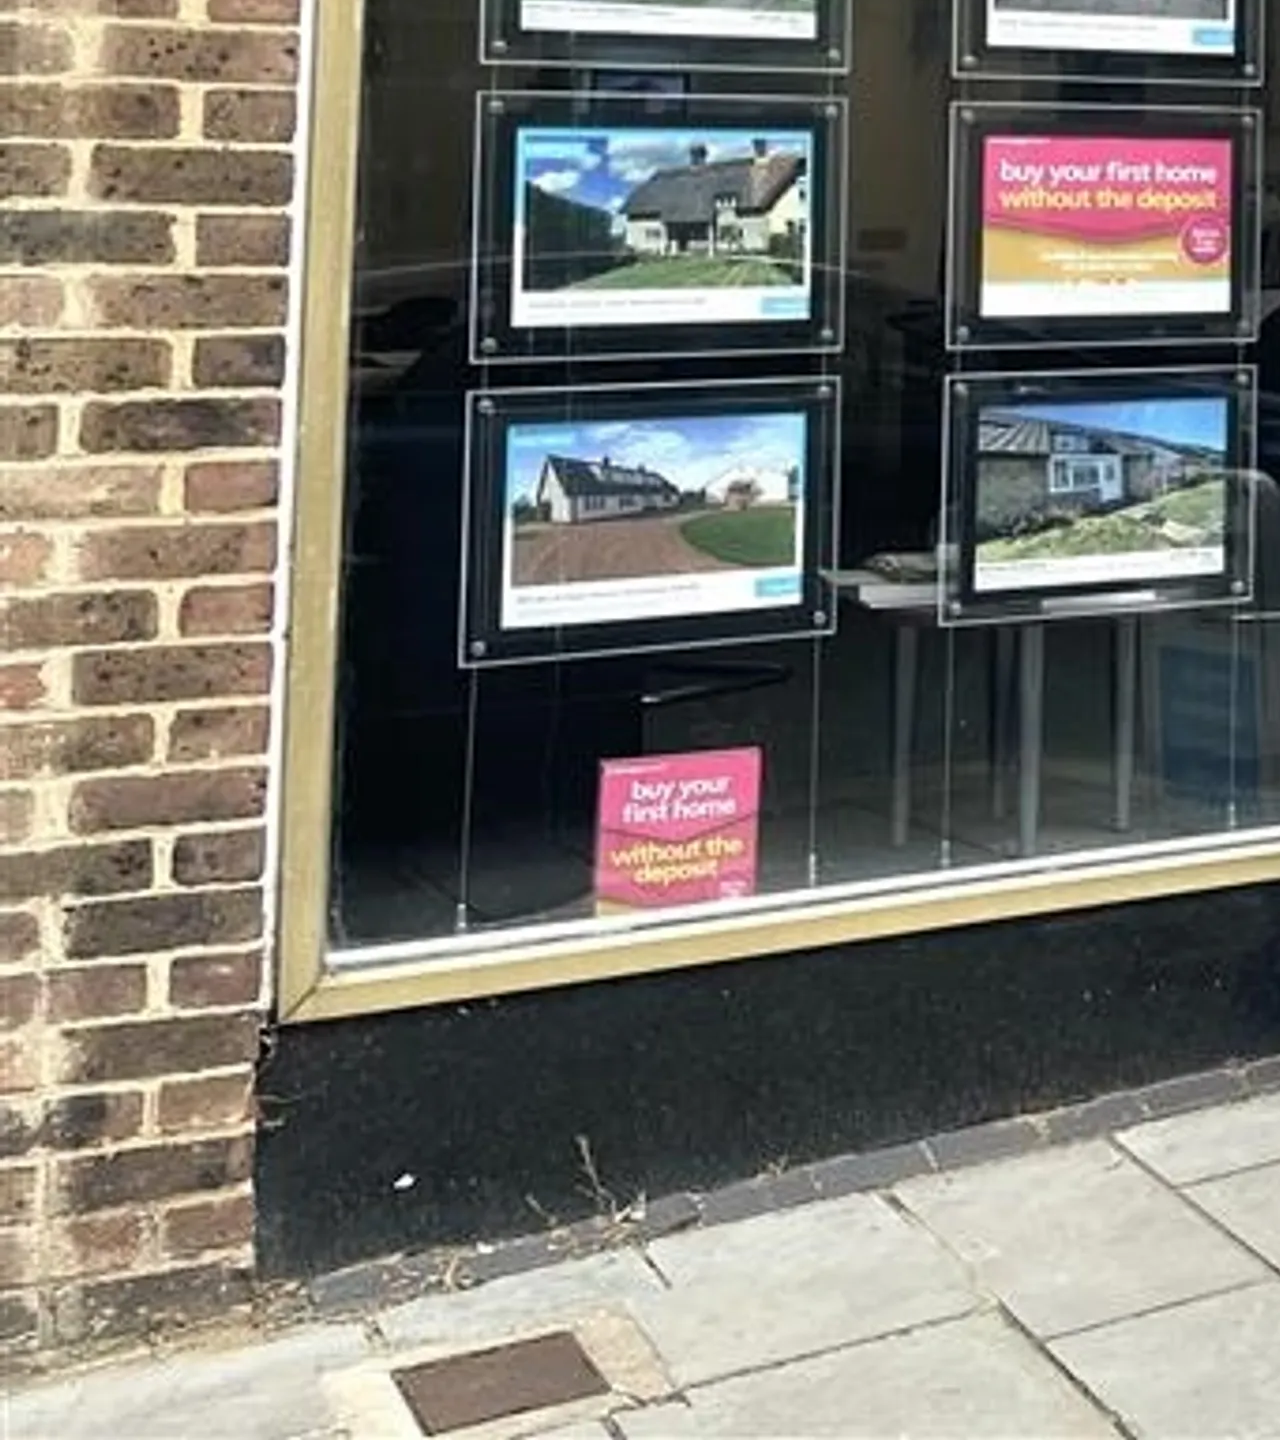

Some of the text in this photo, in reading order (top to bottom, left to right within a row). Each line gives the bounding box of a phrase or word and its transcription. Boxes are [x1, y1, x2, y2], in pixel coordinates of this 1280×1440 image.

[1000, 158, 1218, 188] buy your first home
[999, 186, 1218, 213] without the deposit
[631, 776, 732, 801] buy your
[622, 799, 737, 823] first home
[610, 834, 745, 867] without the
[633, 858, 718, 887] deposit
